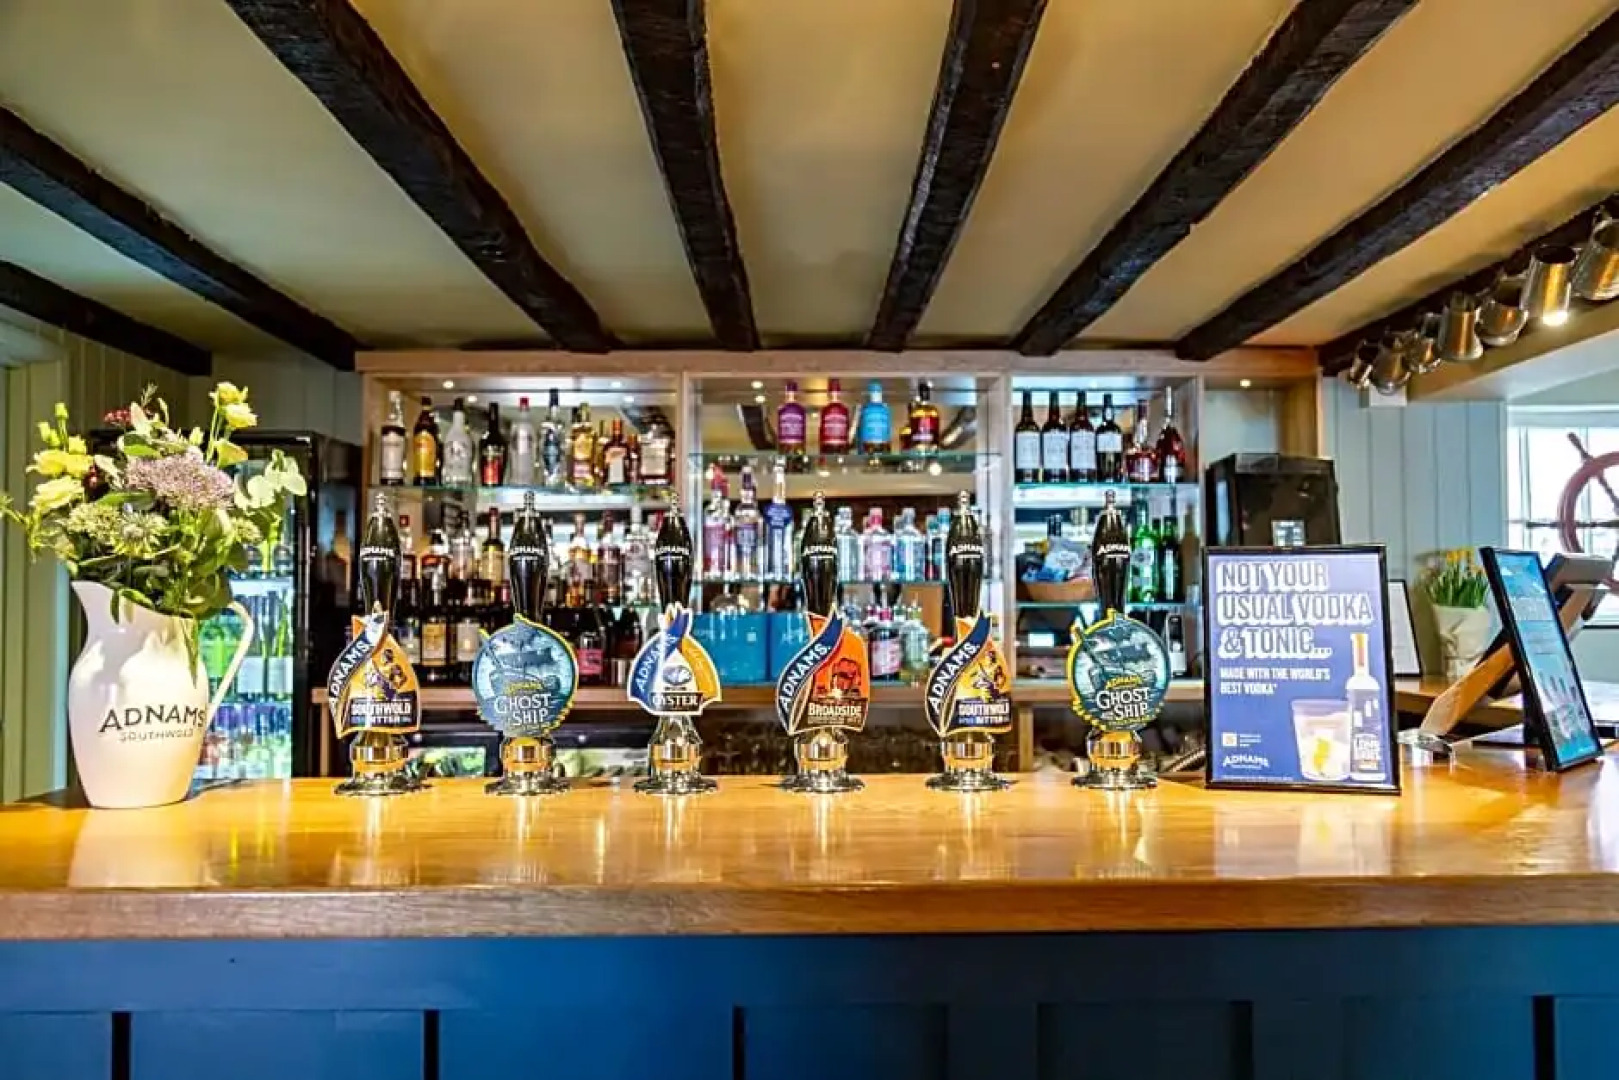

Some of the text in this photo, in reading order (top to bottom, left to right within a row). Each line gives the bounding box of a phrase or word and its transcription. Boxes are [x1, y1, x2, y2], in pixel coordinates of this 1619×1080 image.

[1218, 561, 1328, 592] NOT YOUR
[1218, 593, 1373, 625] USUAL VODKA
[1219, 628, 1243, 659] &
[494, 693, 551, 714] GHOST
[1096, 687, 1149, 709] GHOST
[98, 704, 207, 733] ADNAMS
[512, 708, 549, 726] SHIP
[808, 703, 862, 717] BROADSIDE
[1113, 702, 1148, 721] SHIP
[119, 728, 194, 742] SOUTHWOLD
